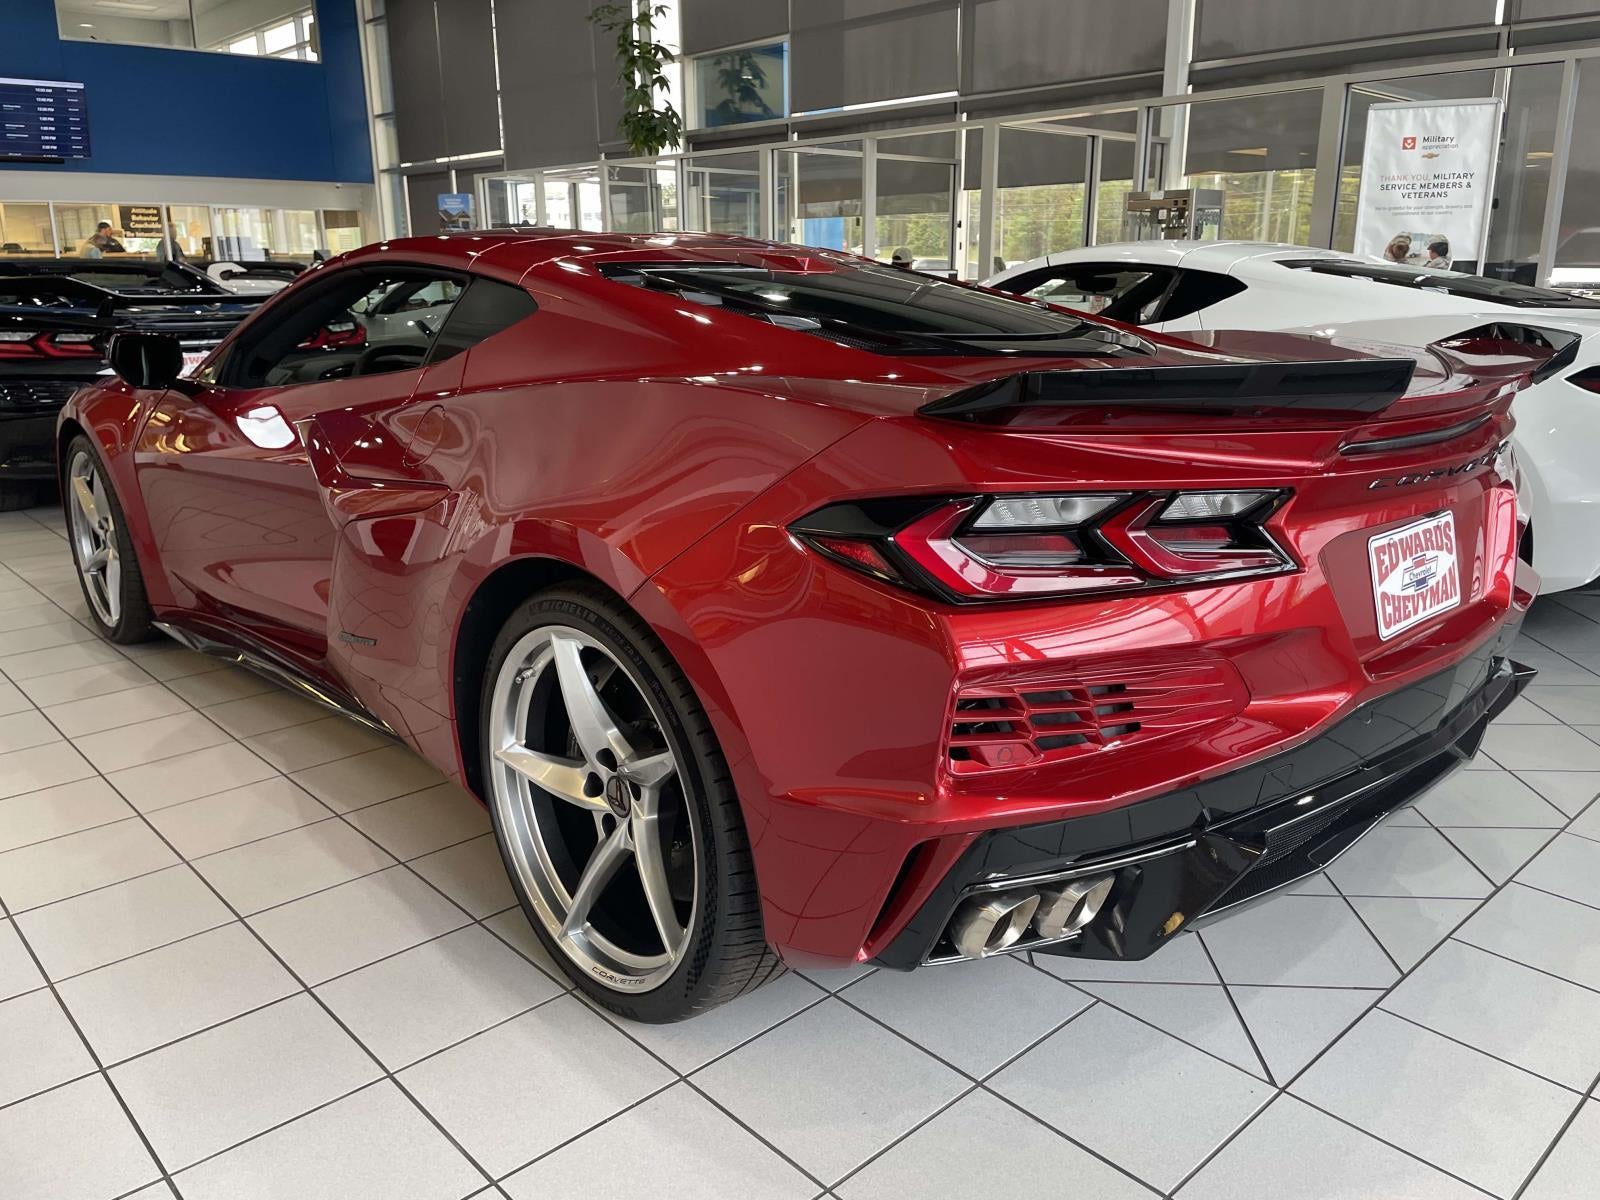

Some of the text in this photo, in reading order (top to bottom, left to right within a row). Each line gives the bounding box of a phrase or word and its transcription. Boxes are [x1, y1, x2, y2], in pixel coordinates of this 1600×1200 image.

[1422, 135, 1455, 143] Military
[1411, 174, 1431, 182] YOU,
[1433, 172, 1475, 180] MILITARY
[1380, 183, 1417, 191] SERVICE
[1419, 182, 1463, 190] MEMBERS
[1401, 191, 1448, 199] VETERANS
[1374, 521, 1454, 587] EDWARDS
[1409, 565, 1432, 581] Chevrolet
[1380, 560, 1458, 630] CHEVYMAN
[542, 599, 598, 624] MICHELIN
[591, 966, 647, 985] CORVETTE
